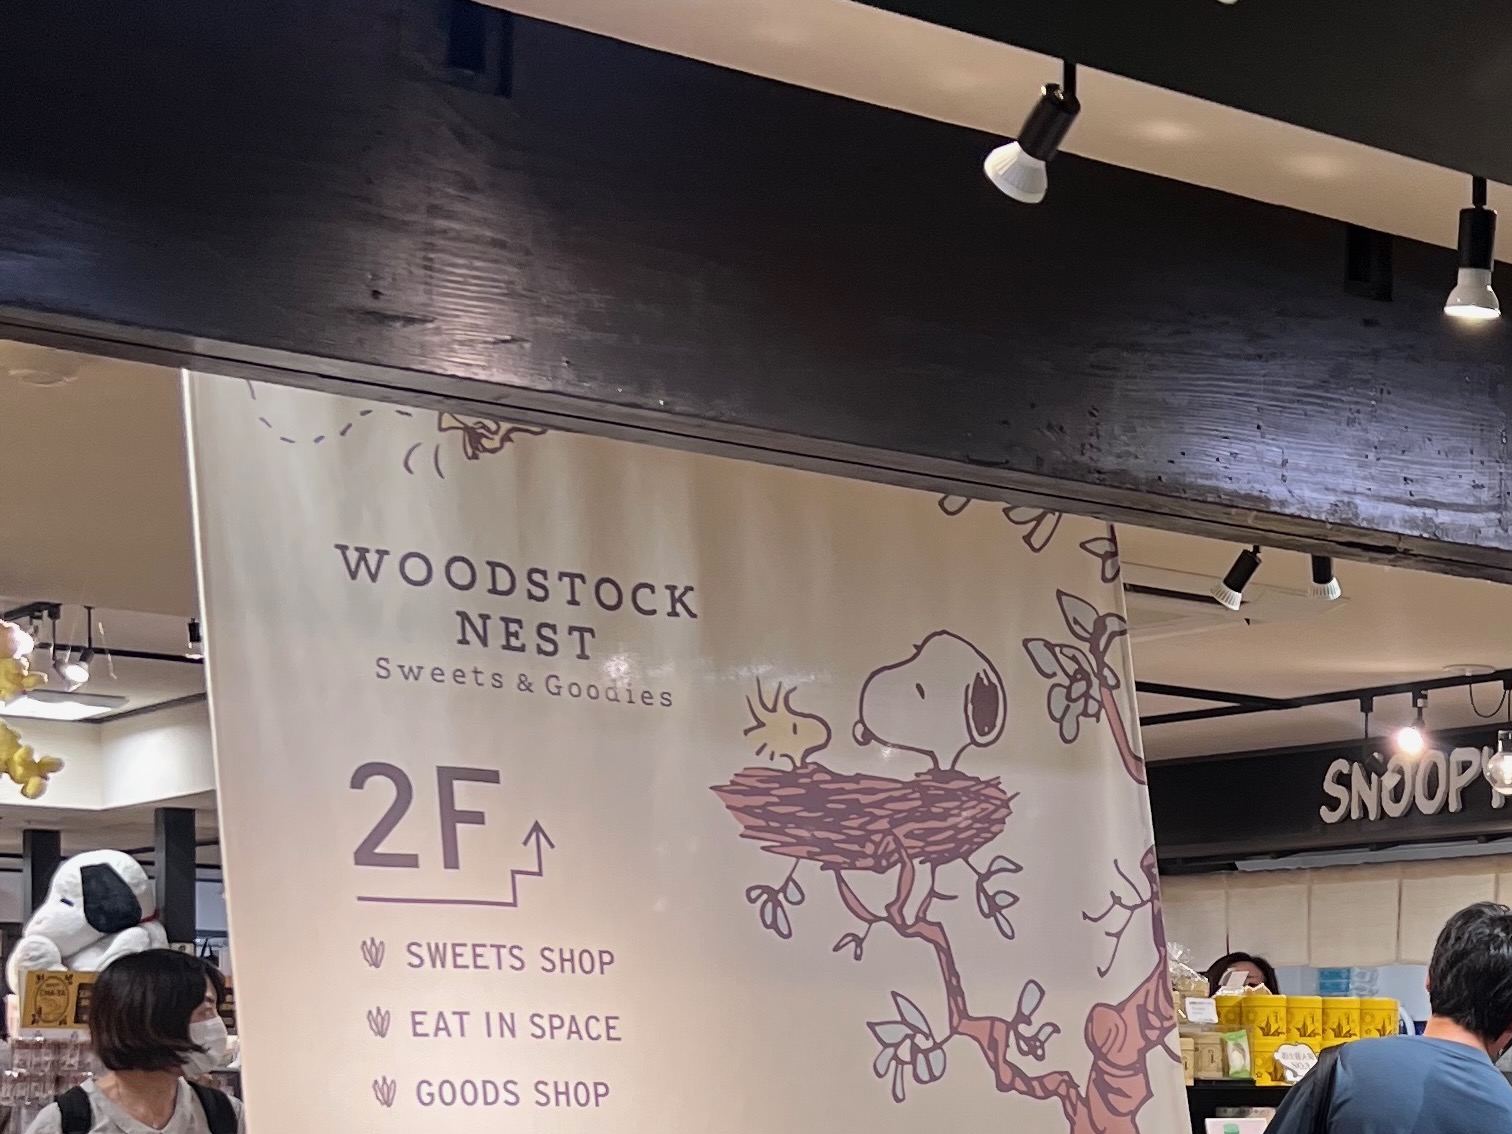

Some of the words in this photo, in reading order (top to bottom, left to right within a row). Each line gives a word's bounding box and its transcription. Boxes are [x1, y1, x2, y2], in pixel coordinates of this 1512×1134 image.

[334, 543, 698, 619] WOODSTOCK
[456, 610, 596, 660] NEST
[375, 656, 504, 690] Sweets
[516, 673, 535, 694] &
[545, 674, 673, 708] Goodies
[1319, 745, 1506, 824] SNOOPY
[350, 761, 501, 869] 2F
[406, 941, 525, 971] SWEETS
[540, 947, 615, 975] SHOP
[410, 1011, 471, 1038] EAT
[485, 1012, 516, 1038] IN
[530, 1013, 622, 1041] SPACE
[416, 1079, 520, 1107] GOODS
[534, 1080, 610, 1107] SHOP
